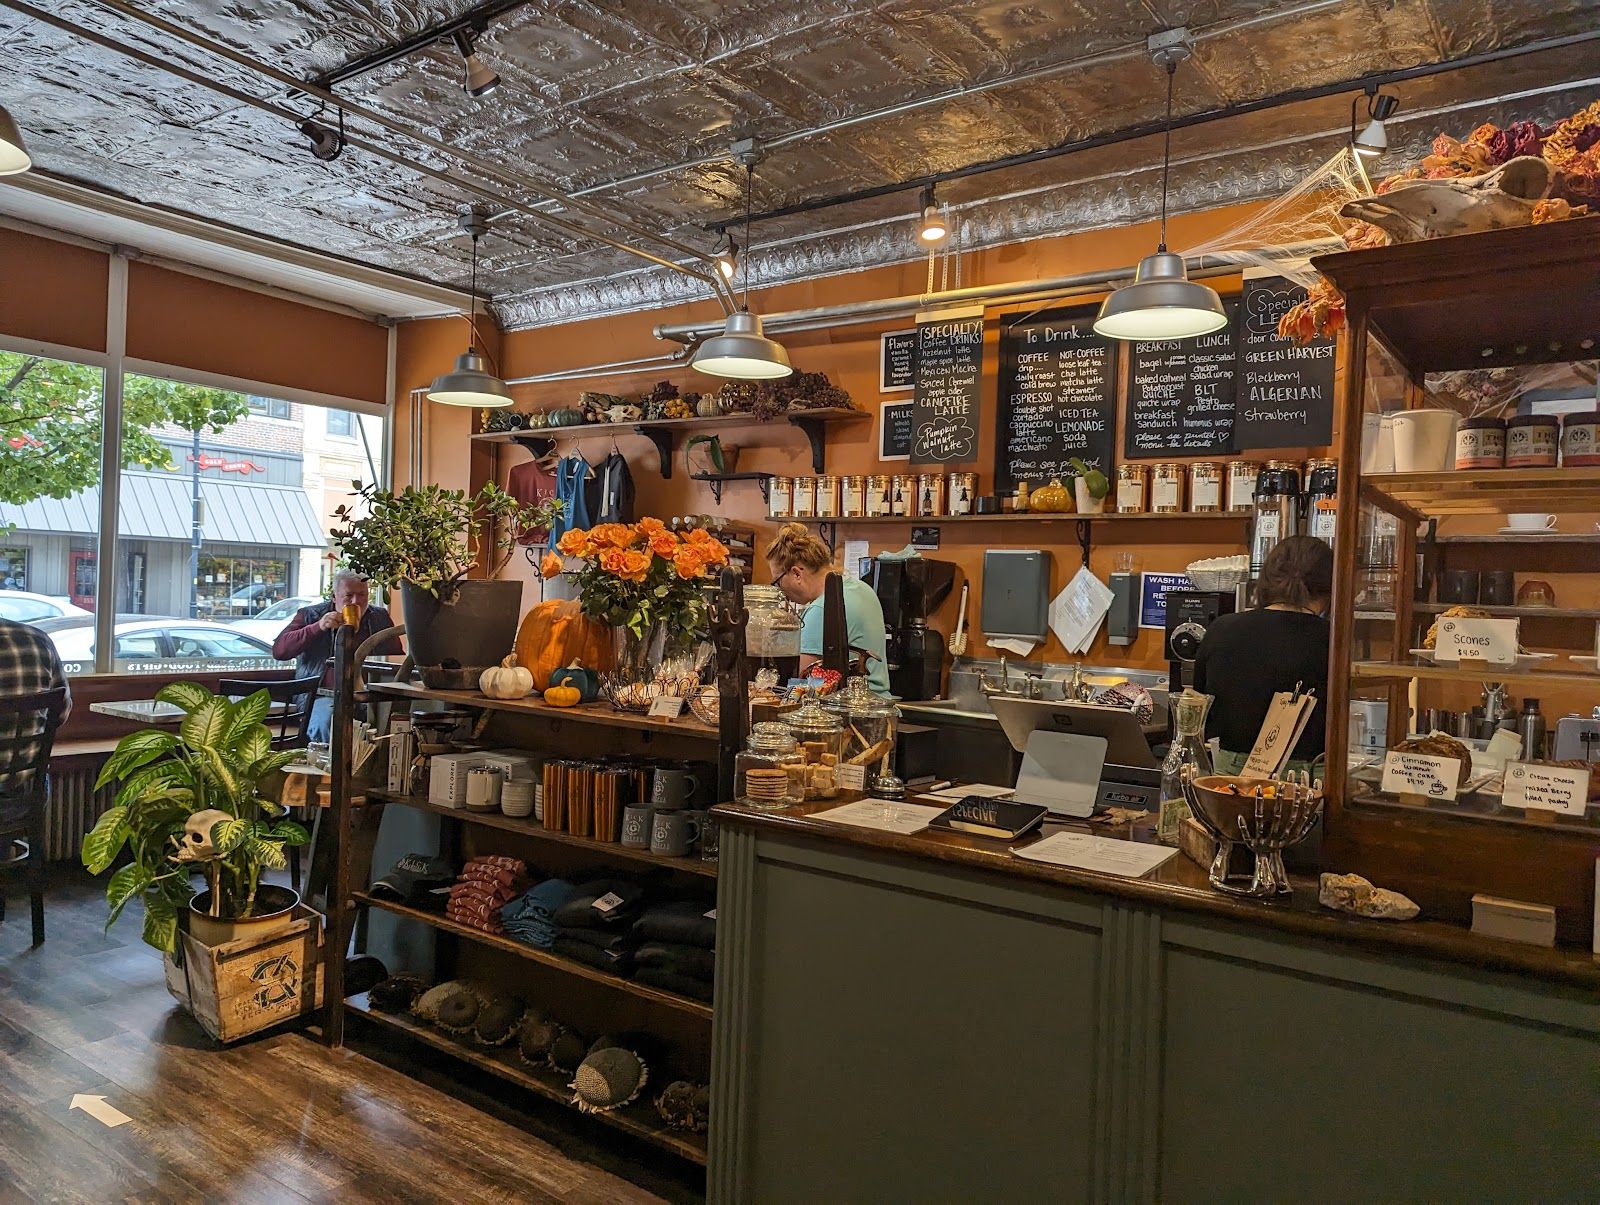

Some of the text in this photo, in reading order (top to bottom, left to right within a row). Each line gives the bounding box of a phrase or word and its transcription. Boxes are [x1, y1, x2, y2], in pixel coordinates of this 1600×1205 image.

[924, 322, 979, 340] SPECIALTY
[1024, 328, 1038, 343] To
[888, 338, 914, 349] flavors
[923, 334, 979, 349] coffee DRINKS
[1196, 334, 1230, 348] LUNCH
[1247, 333, 1267, 344] door
[922, 346, 972, 356] hazelnut latte
[1136, 340, 1181, 354] BREAKFAST
[892, 354, 912, 362] caramel
[956, 355, 972, 363] latte
[1018, 352, 1049, 364] COFFEE
[1188, 352, 1236, 364] classic salad
[1246, 345, 1336, 363] GREEN HARVEST
[1059, 361, 1077, 369] loose
[1078, 359, 1090, 367] leaf
[1140, 358, 1162, 372] bagel
[1193, 364, 1219, 373] chicken
[921, 364, 978, 377] Mexican Mocha
[1061, 368, 1098, 378] chai latte
[1190, 370, 1234, 380] salad wrap
[948, 375, 975, 387] Caramel
[1015, 372, 1055, 383] daily roast
[1060, 376, 1104, 386] matcha latte
[1135, 372, 1187, 385] baked oatmeal
[1246, 371, 1300, 384] Blackberry
[1020, 381, 1037, 390] cold
[1062, 386, 1098, 395] steamer
[1195, 383, 1218, 396] BLT
[928, 388, 945, 397] apple
[1142, 389, 1175, 399] QUICHE
[1250, 385, 1322, 403] ALGERIAN
[921, 394, 971, 407] CAMPFIRE
[1010, 392, 1053, 405] ESPRESSO
[1057, 394, 1103, 403] hot chocolate
[1013, 404, 1054, 414] double shot
[1137, 399, 1181, 410] quiche wrap
[1187, 402, 1235, 415] grilled cheese
[934, 405, 970, 416] LATTE
[1059, 408, 1099, 418] ICED TEA
[1134, 409, 1176, 420] breakfast
[1245, 407, 1307, 425] Strawberry
[1013, 413, 1044, 421] cortado
[1183, 417, 1234, 428] hummus wrap
[1009, 420, 1053, 430] cappuccino
[1055, 420, 1105, 433] LEMONADE
[1137, 419, 1177, 428] sandwich
[924, 424, 957, 438] Pumpkin
[1016, 428, 1036, 437] latte
[923, 434, 954, 450] Walnut
[1010, 436, 1052, 444] americano
[1063, 432, 1086, 442] soda
[1135, 432, 1162, 445] please
[940, 440, 962, 453] latte
[1008, 443, 1047, 452] macchiato
[1062, 441, 1088, 451] juice
[1040, 461, 1057, 470] see
[1010, 471, 1044, 480] menus
[536, 488, 555, 497] KIC
[1149, 576, 1175, 585] WASH
[1454, 633, 1490, 646] Scones
[1458, 648, 1480, 656] $4.50
[1401, 755, 1441, 768] Cinnamon
